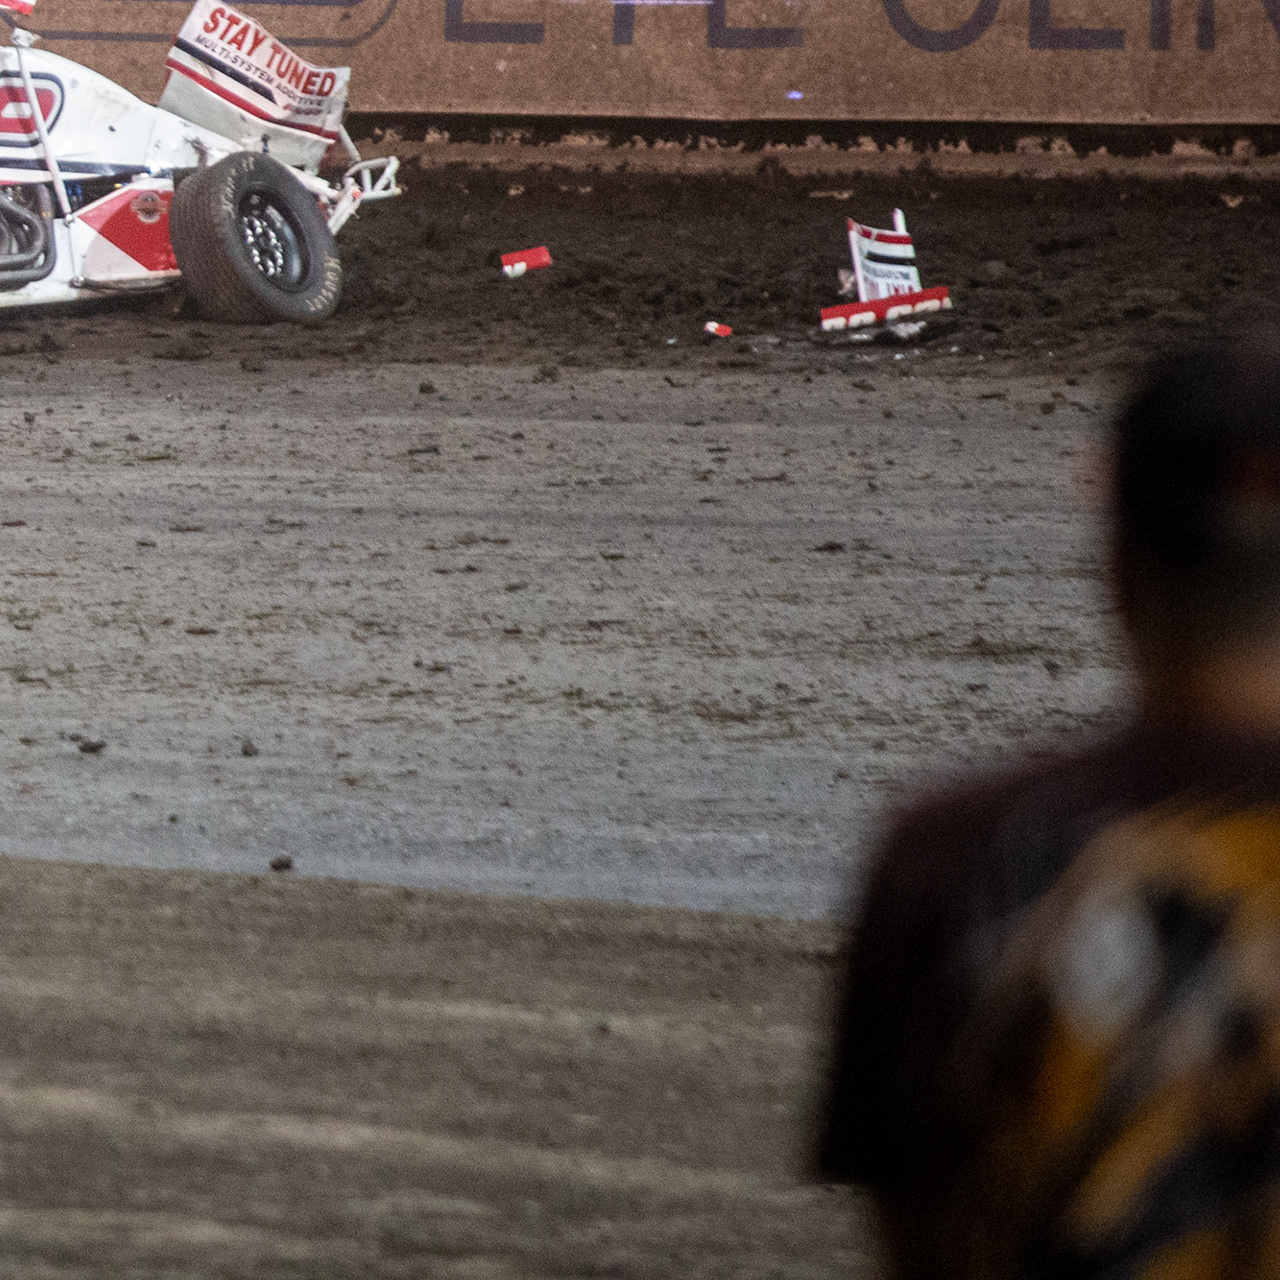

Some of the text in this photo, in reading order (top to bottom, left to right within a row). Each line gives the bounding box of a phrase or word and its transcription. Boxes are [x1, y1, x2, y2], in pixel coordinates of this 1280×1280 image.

[195, 34, 275, 87] MULTI-SYSTEM
[202, 7, 337, 97] STAY TUNED
